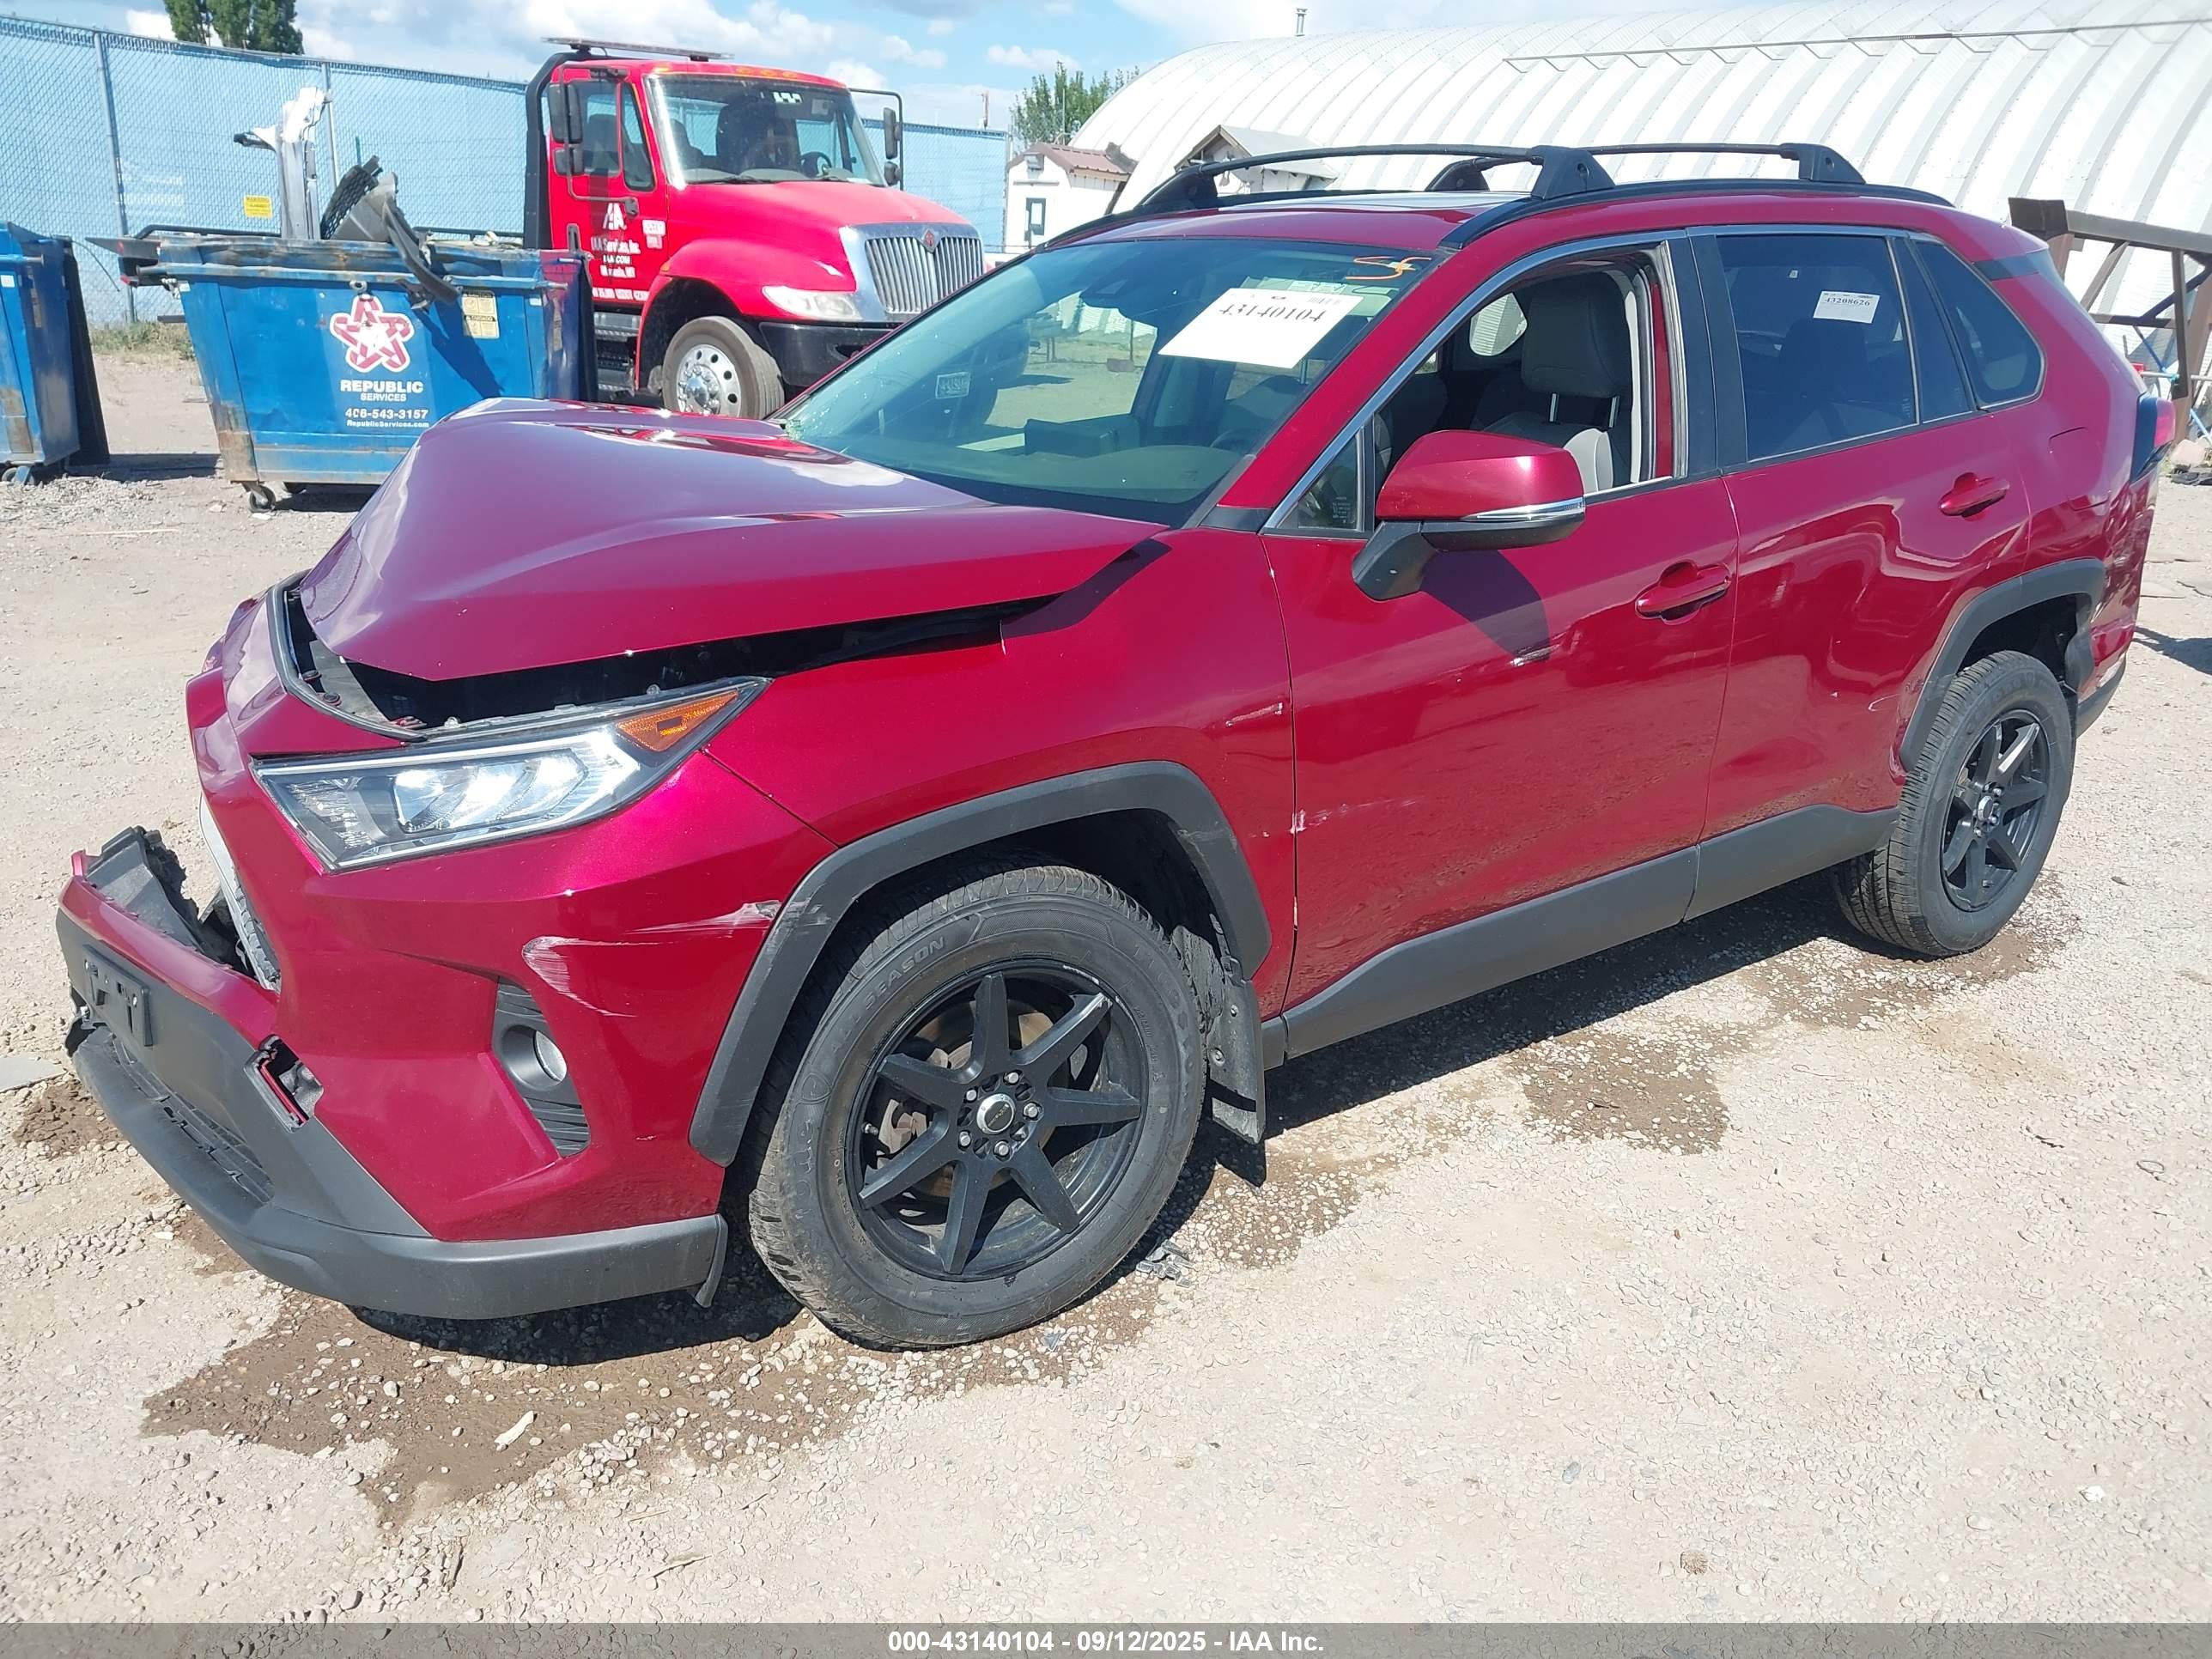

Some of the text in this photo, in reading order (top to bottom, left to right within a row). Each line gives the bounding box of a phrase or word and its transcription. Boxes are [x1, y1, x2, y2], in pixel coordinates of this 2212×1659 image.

[1825, 297, 1870, 306] 43208626
[340, 380, 424, 393] REPUBLIC
[360, 393, 407, 402] SERVICES
[346, 419, 429, 428] RepublicServices.com
[864, 936, 945, 1011] SEASON
